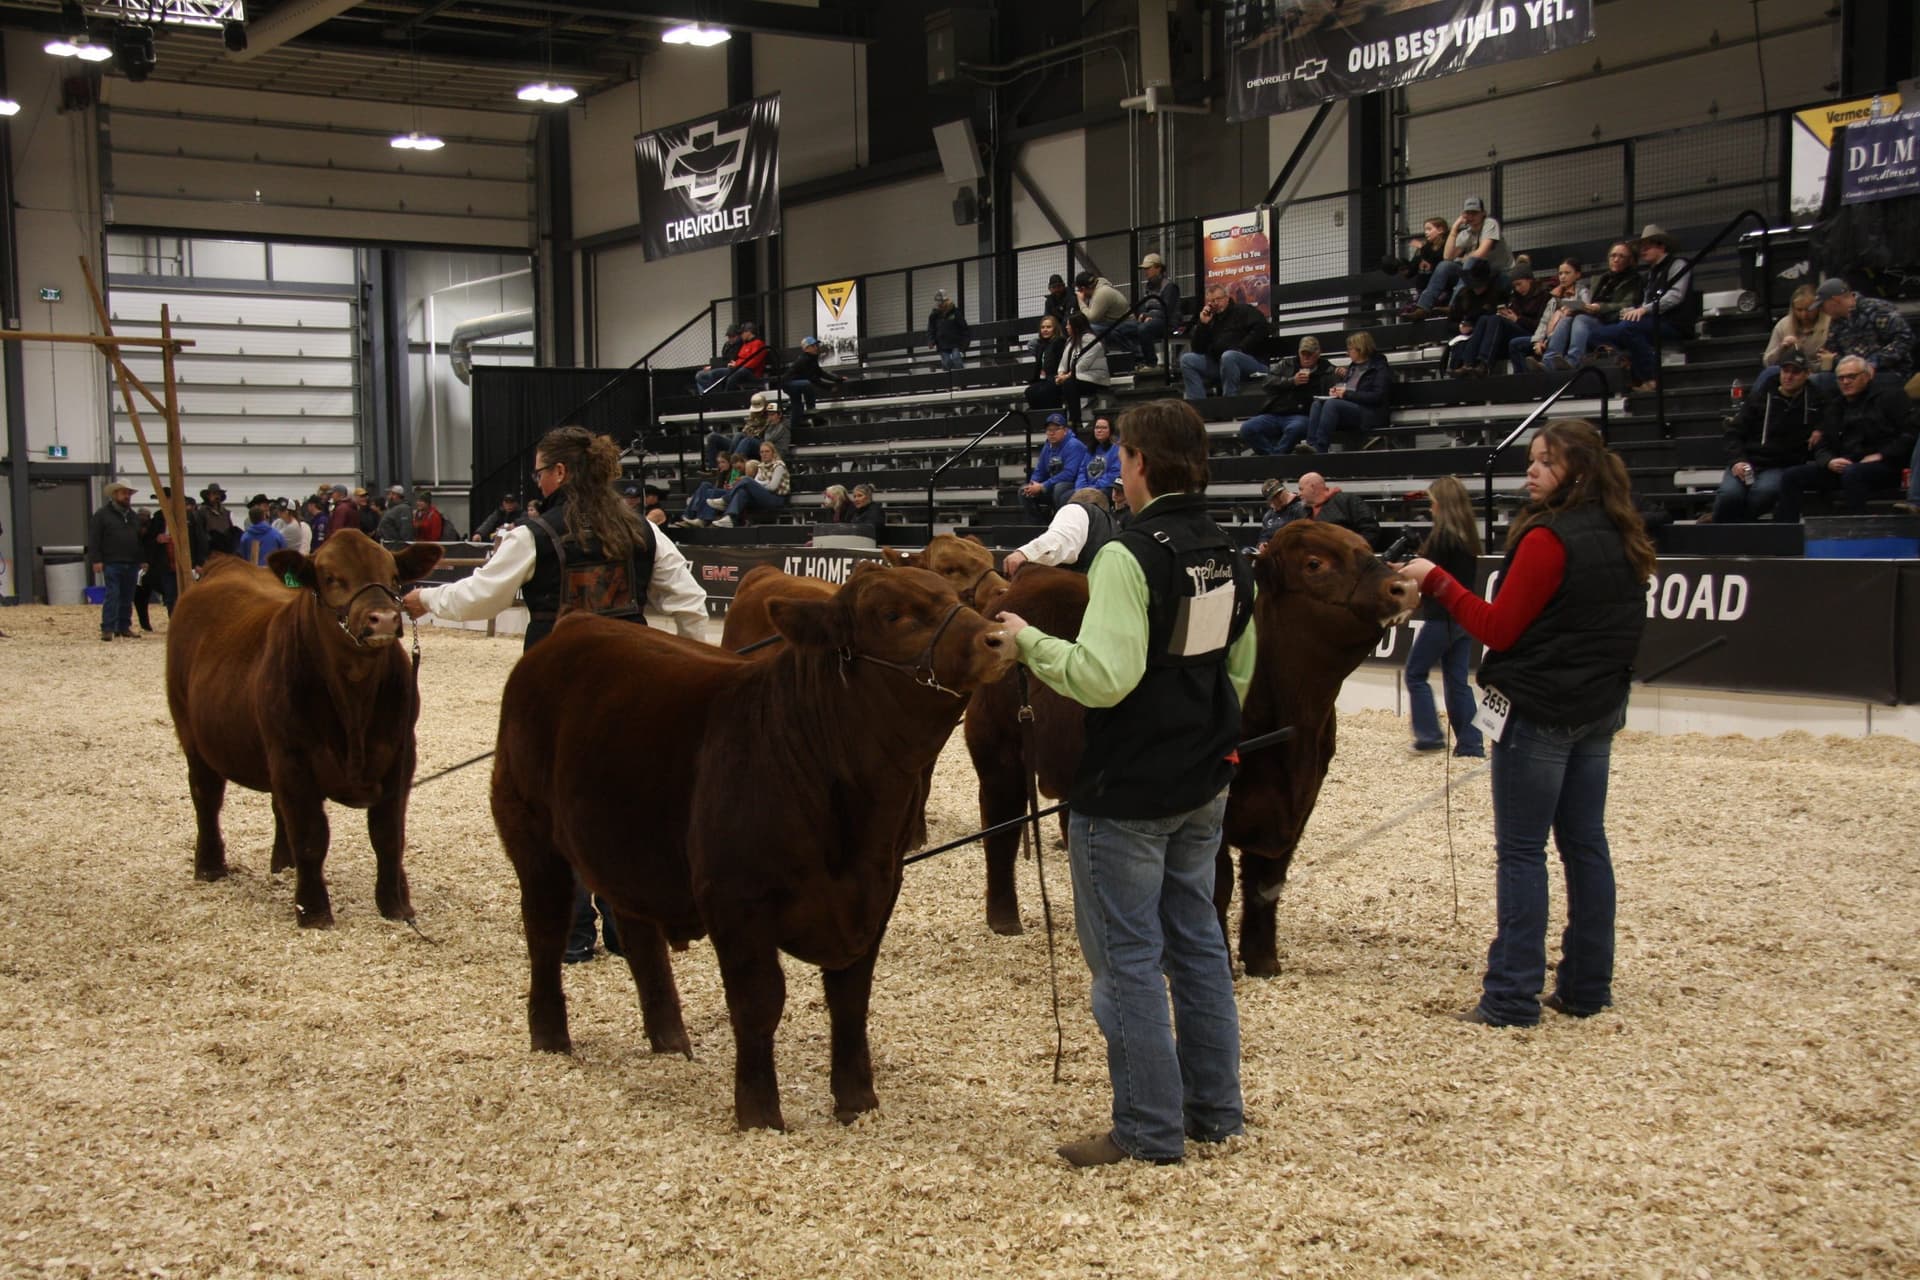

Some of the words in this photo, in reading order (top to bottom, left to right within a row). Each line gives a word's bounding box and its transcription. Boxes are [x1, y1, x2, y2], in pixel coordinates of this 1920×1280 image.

[1348, 40, 1390, 72] OUR
[1395, 24, 1449, 62] BEST
[1453, 7, 1516, 47] YIELD
[1524, 0, 1574, 29] YET.
[1247, 73, 1291, 88] CHEVROLET
[1826, 108, 1873, 122] Vermee
[665, 205, 752, 243] CHEVROLET
[702, 565, 739, 582] GMC
[784, 556, 801, 576] AT
[806, 557, 853, 585] HOME
[1482, 688, 1509, 718] 2653
